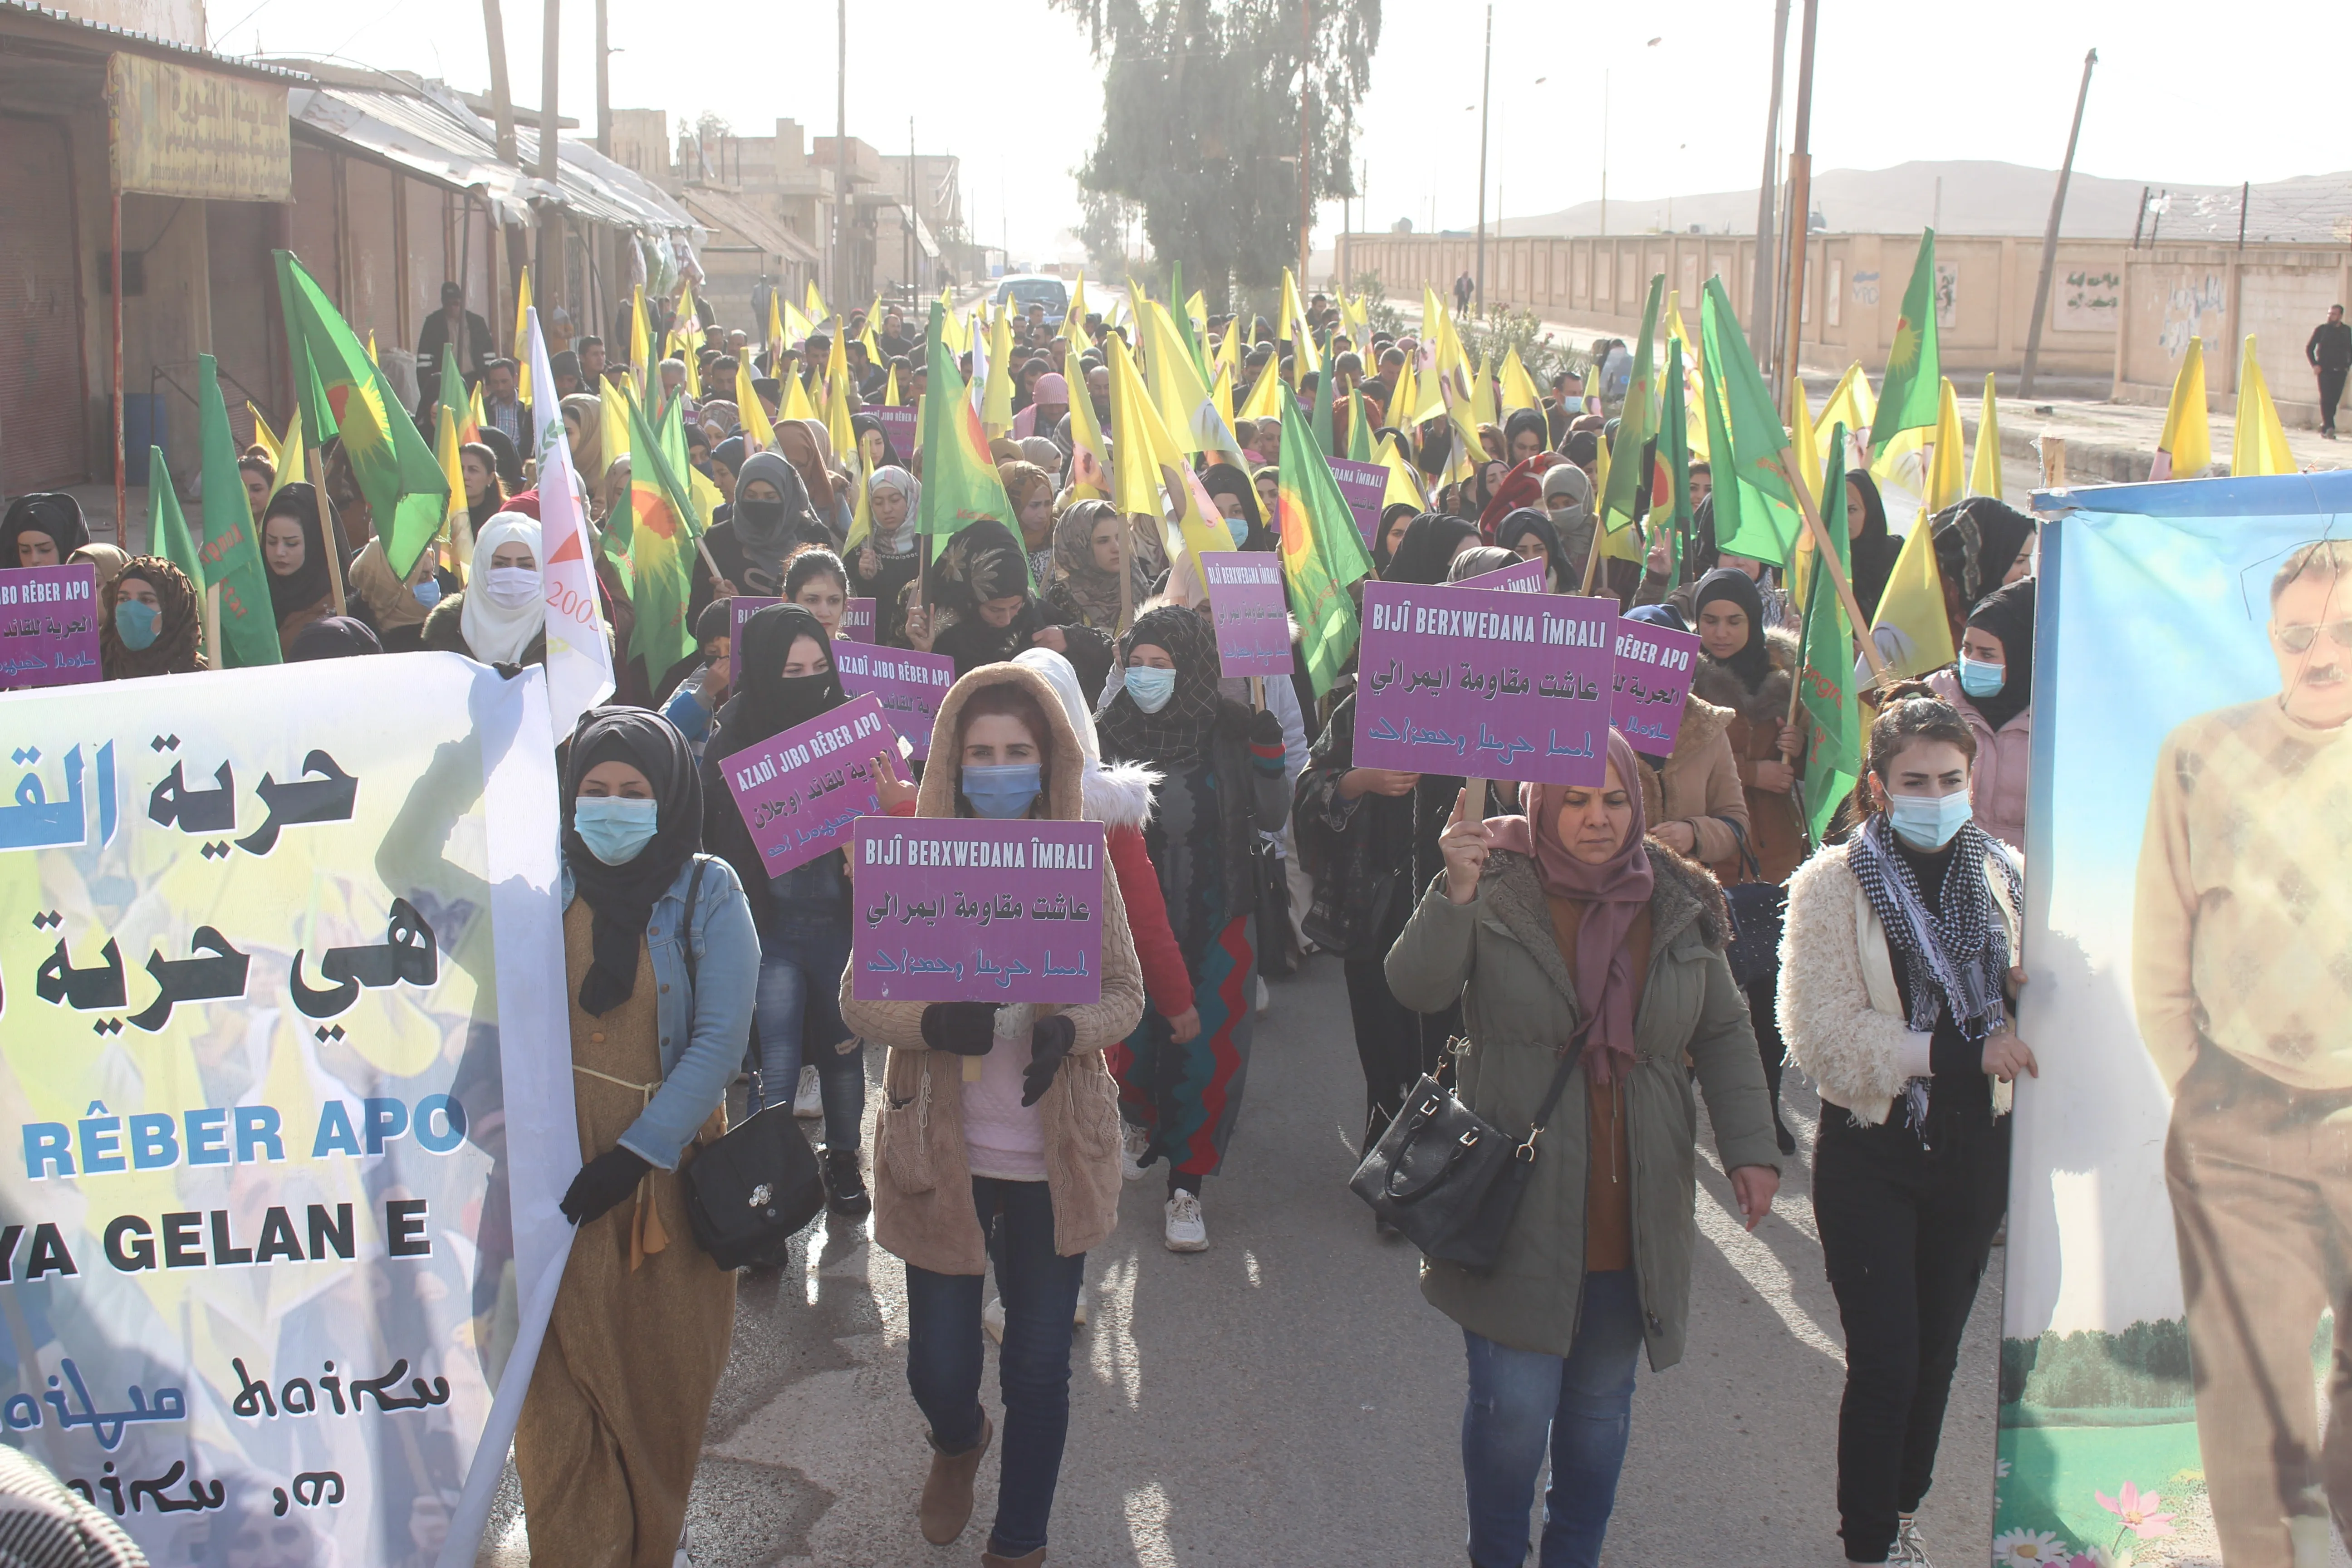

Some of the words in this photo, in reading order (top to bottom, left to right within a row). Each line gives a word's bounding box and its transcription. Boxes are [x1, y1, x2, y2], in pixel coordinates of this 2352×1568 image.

[1329, 467, 1353, 483] EDANA
[1356, 470, 1383, 488] ÎMRALI
[0, 586, 17, 605] BO
[22, 580, 60, 603] RÊBER
[65, 580, 89, 600] APO
[1207, 563, 1222, 584] BIJÎ
[1221, 567, 1260, 584] BERXWEDANA
[1258, 564, 1279, 584] ÎMRALI
[46, 615, 93, 640] الحرية
[1373, 600, 1411, 632] BIJÎ
[1416, 607, 1535, 642] BERXWEDANA
[1542, 612, 1606, 648] ÎMRALI
[839, 655, 868, 676] AZADÎ
[872, 660, 895, 679] JIBO
[898, 661, 929, 684] RÊBER
[932, 668, 950, 687] APO
[1615, 633, 1658, 664] RÊBER
[1659, 647, 1689, 671] APO
[1369, 657, 1451, 697] ايمرالي
[1459, 662, 1530, 701] مقاومة
[1538, 670, 1600, 701] عاشت
[1629, 676, 1681, 706] الحرية
[736, 754, 777, 792] AZADÎ
[779, 743, 811, 773] JIBO
[809, 725, 854, 759] RÊBER
[853, 712, 882, 740] APO
[148, 733, 359, 860] حرية
[808, 769, 846, 801] للقائد
[753, 789, 803, 829] اوجلان
[866, 834, 903, 866] BIJÎ
[908, 839, 1025, 868] BERXWEDANA
[1030, 837, 1093, 870] ÎMRALI
[866, 891, 946, 930] ايمرالي
[953, 890, 1024, 926] مقاومة
[1030, 892, 1091, 921] عاشت
[35, 910, 252, 1037] حرية
[290, 897, 440, 1044] هي
[21, 1100, 286, 1181] RÊBER
[311, 1093, 469, 1159] APO
[103, 1199, 358, 1273] GELAN
[385, 1199, 433, 1259] E
